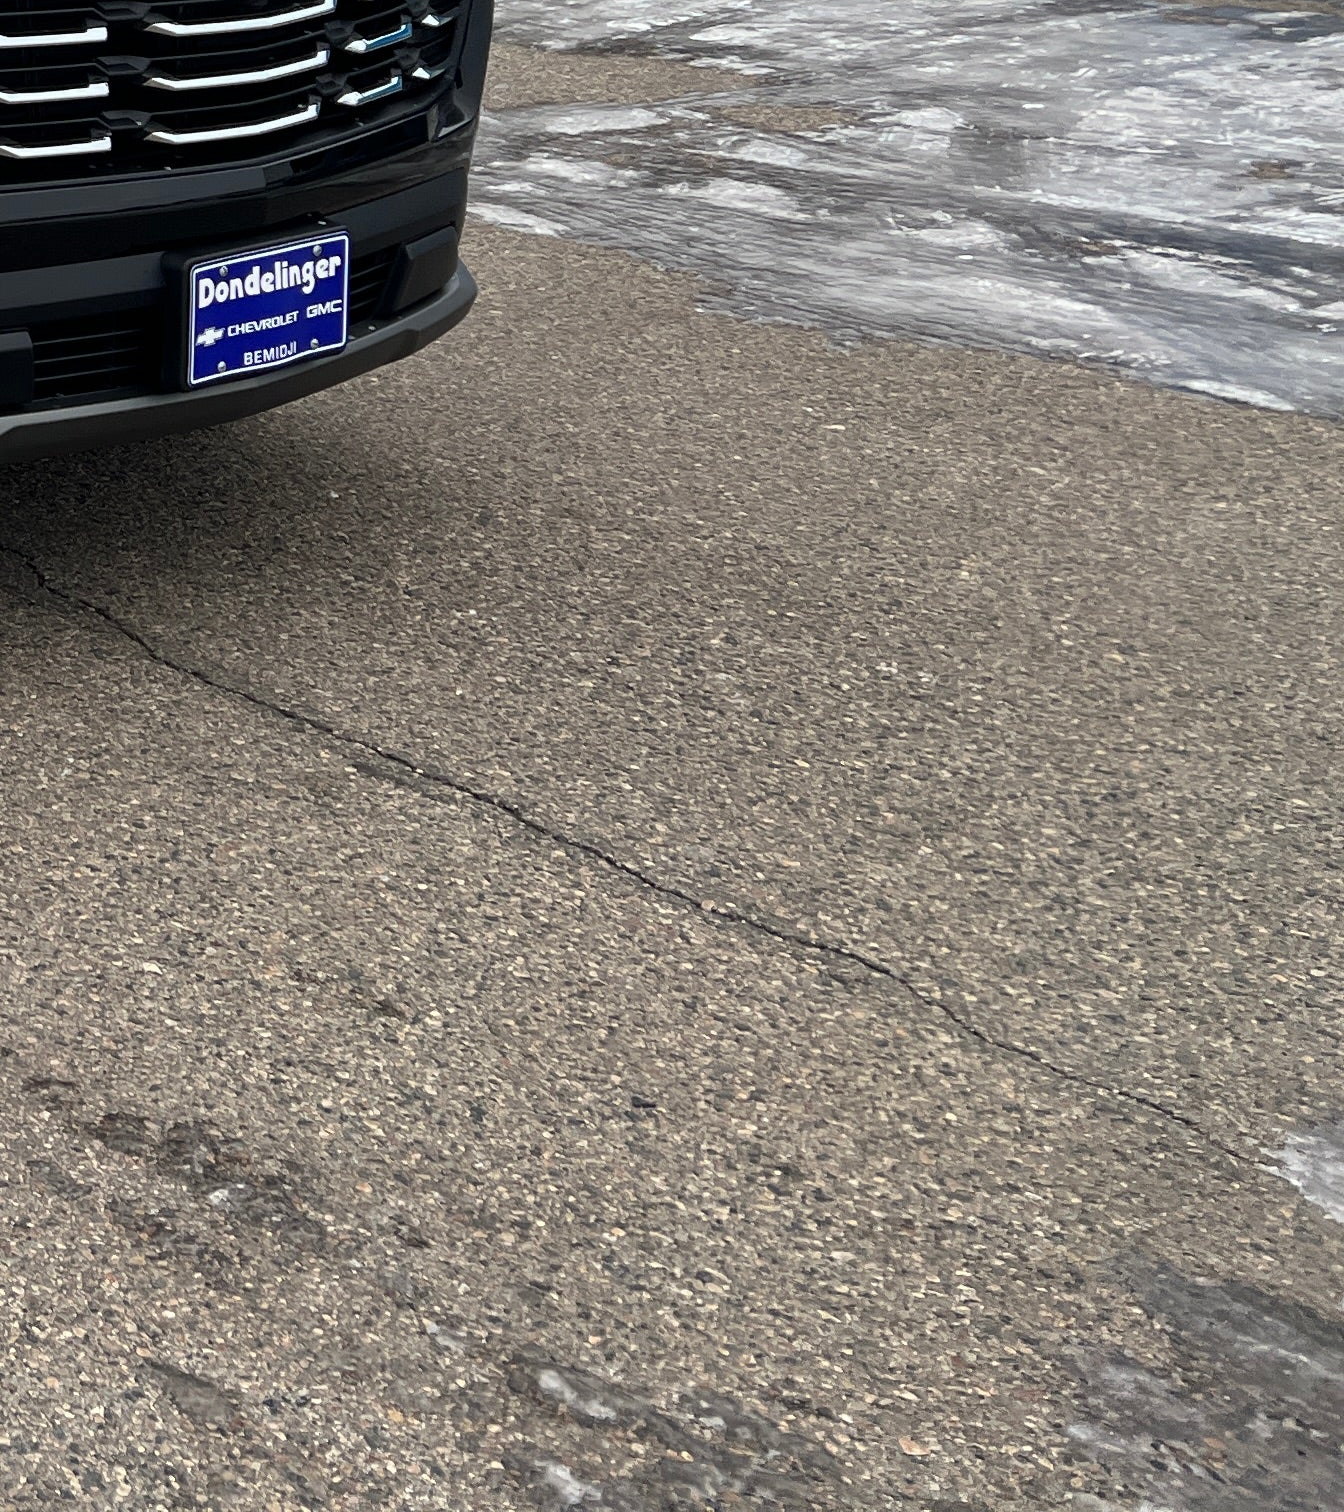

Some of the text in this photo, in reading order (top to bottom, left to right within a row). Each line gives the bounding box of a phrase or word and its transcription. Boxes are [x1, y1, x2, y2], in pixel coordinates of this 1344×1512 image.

[198, 255, 342, 309] Dondelinger
[227, 299, 343, 338] CHEVROLET GMC
[243, 340, 297, 366] BEMIDJI
